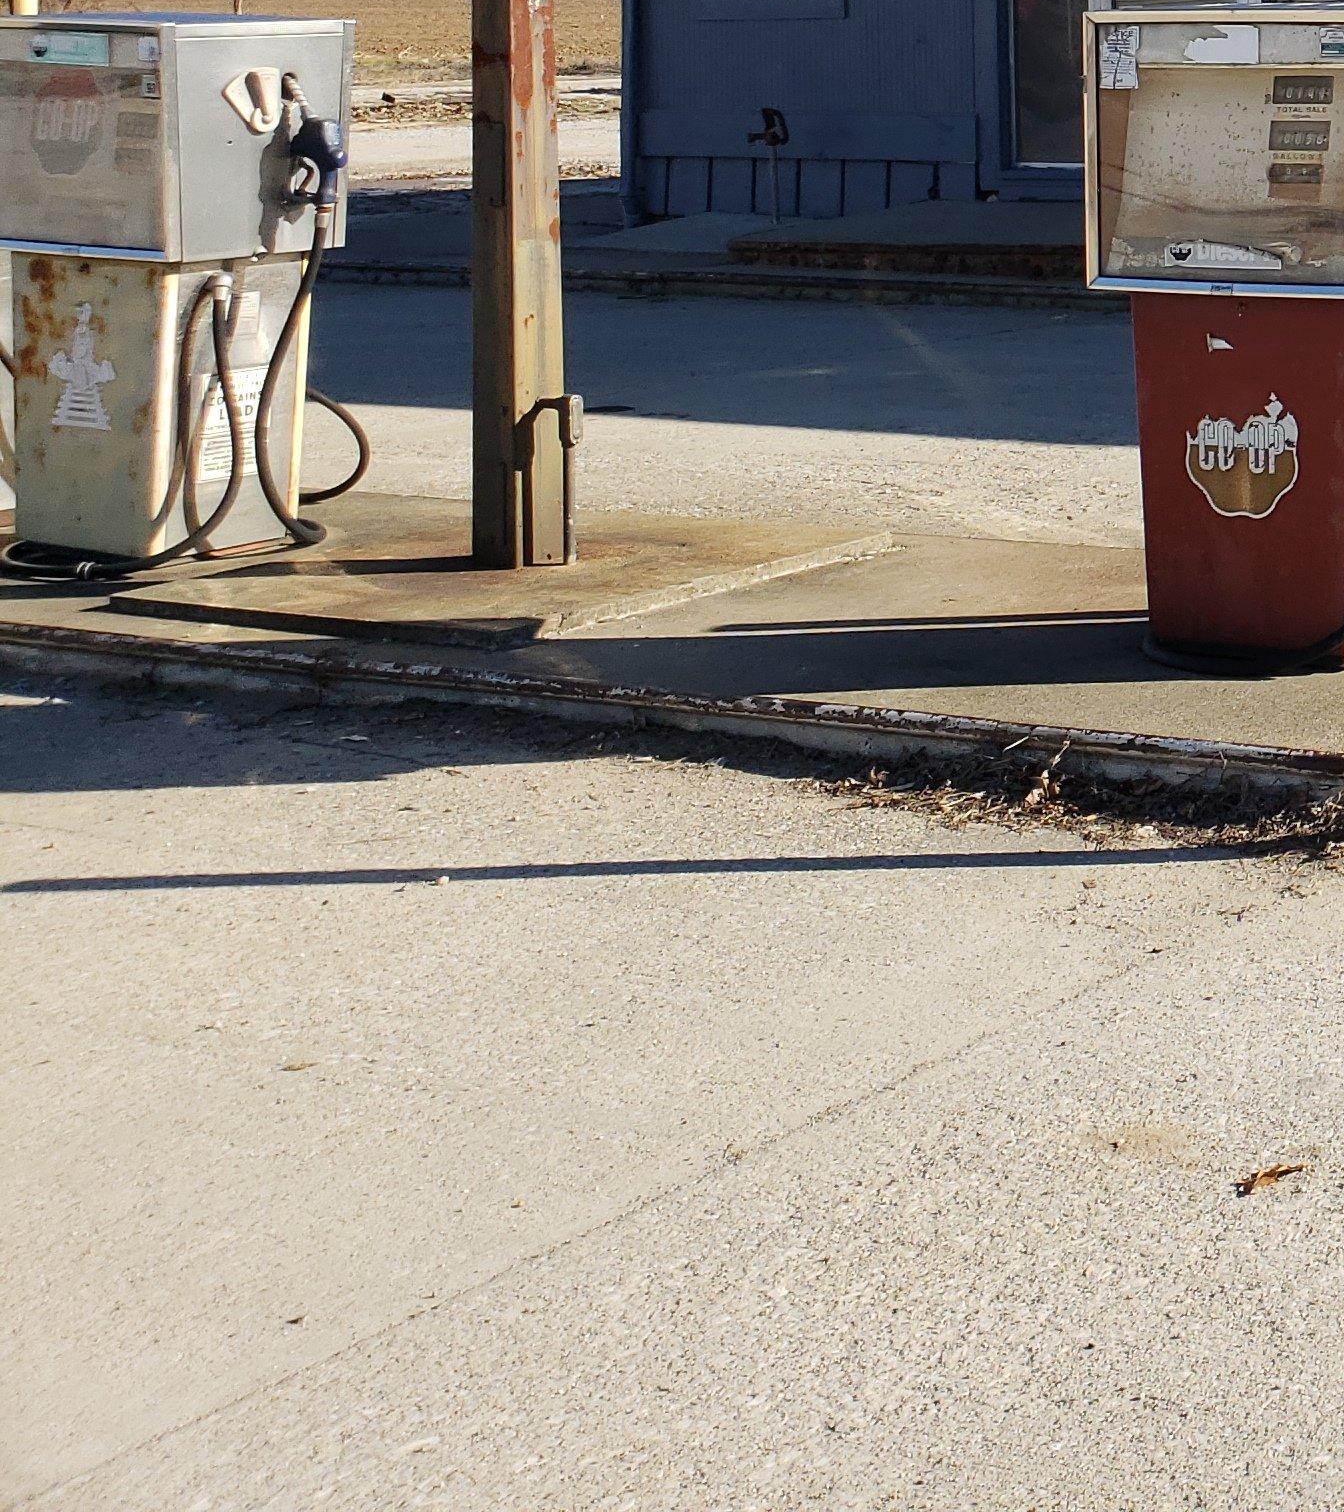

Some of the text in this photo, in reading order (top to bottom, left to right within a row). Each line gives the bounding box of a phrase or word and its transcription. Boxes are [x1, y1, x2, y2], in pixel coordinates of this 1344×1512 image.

[207, 390, 263, 407] COAIN
[219, 405, 254, 420] LD
[1198, 419, 1286, 475] CO-OP
